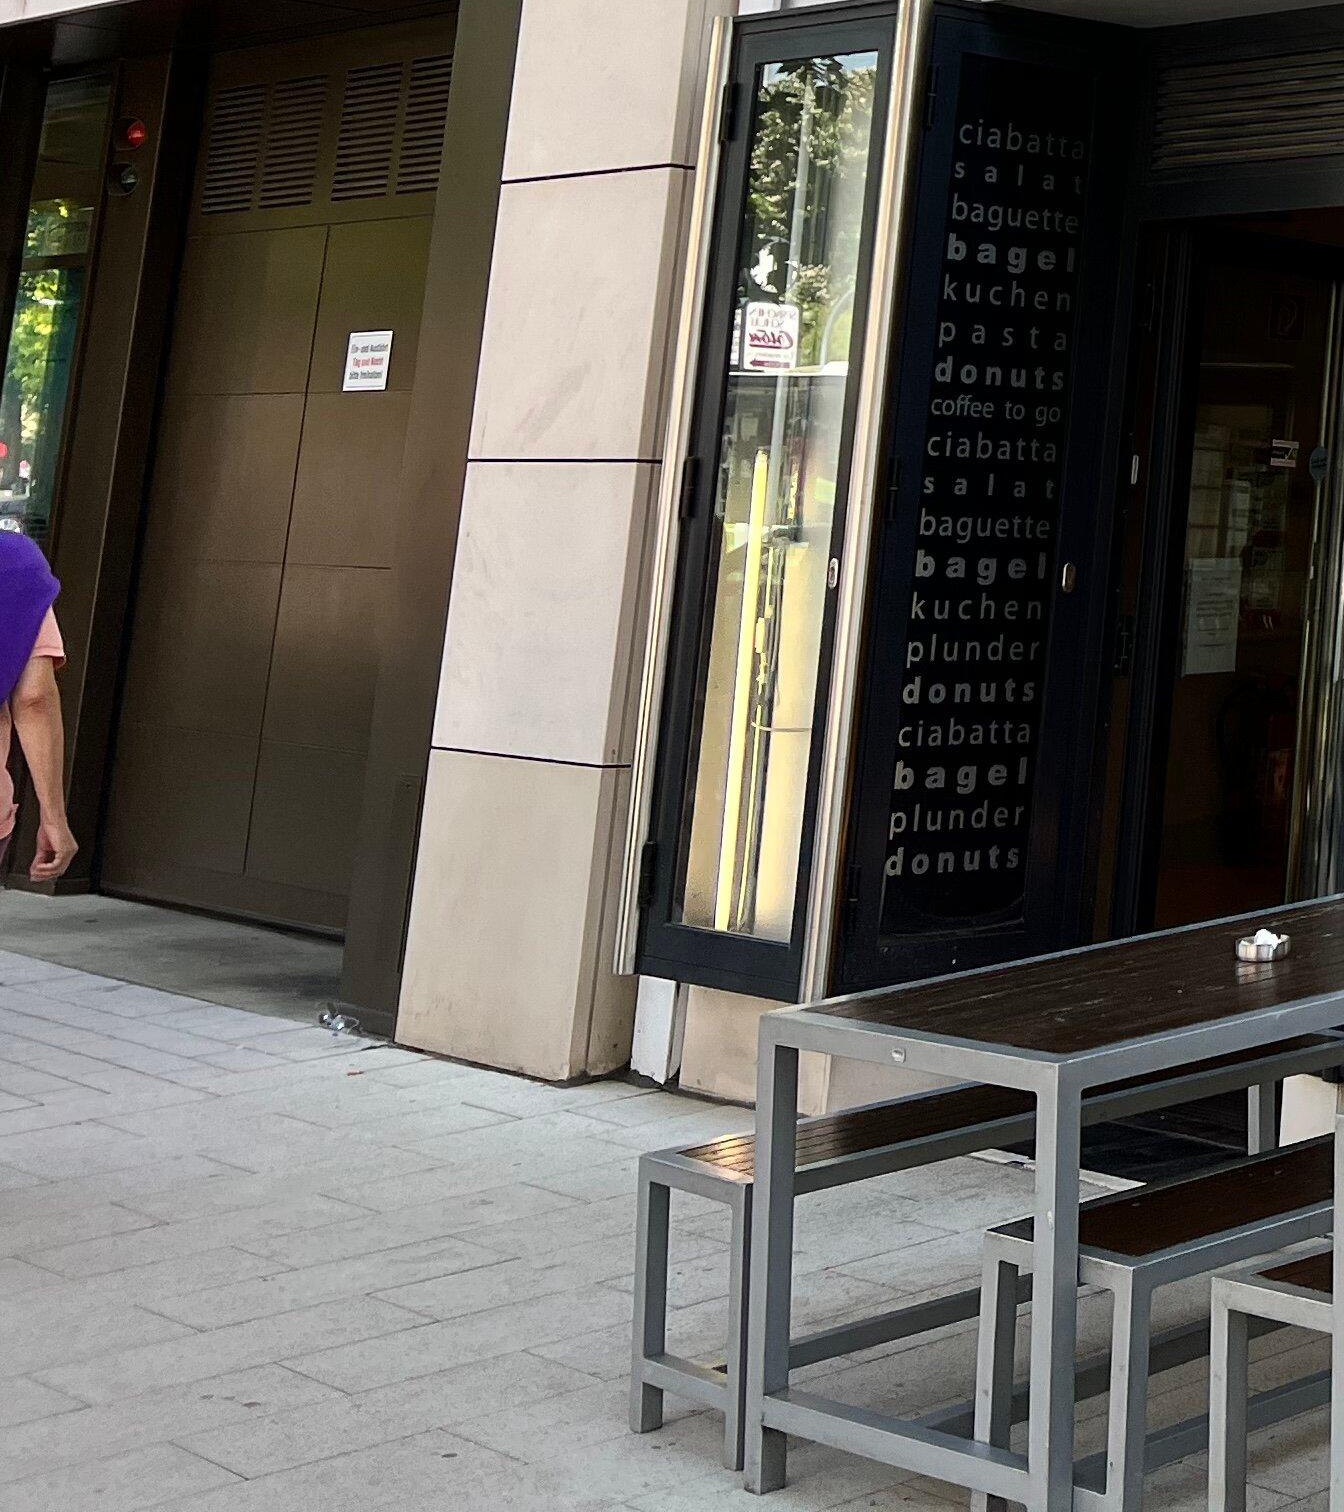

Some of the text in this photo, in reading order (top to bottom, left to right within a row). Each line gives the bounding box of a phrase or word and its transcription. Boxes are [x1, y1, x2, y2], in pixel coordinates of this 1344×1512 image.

[958, 117, 1085, 161] ciabatta
[953, 162, 1083, 195] salat
[951, 192, 1079, 234] baguette
[946, 232, 1076, 275] bagel
[942, 274, 1071, 313] kuchen
[938, 320, 1068, 352] pasta
[933, 355, 1064, 392] donuts
[930, 394, 1061, 427] coffee to go
[926, 430, 1058, 464] ciabatta
[922, 472, 1055, 499] salat
[919, 507, 1051, 544] baguette
[914, 549, 1048, 586] bagel
[910, 591, 1042, 621] kuchen
[906, 633, 1041, 669] plunder
[902, 675, 1036, 705] donuts
[898, 717, 1031, 748] ciabatta
[893, 756, 1028, 794] bagel
[888, 799, 1025, 840] plunder
[884, 843, 1020, 877] donuts
